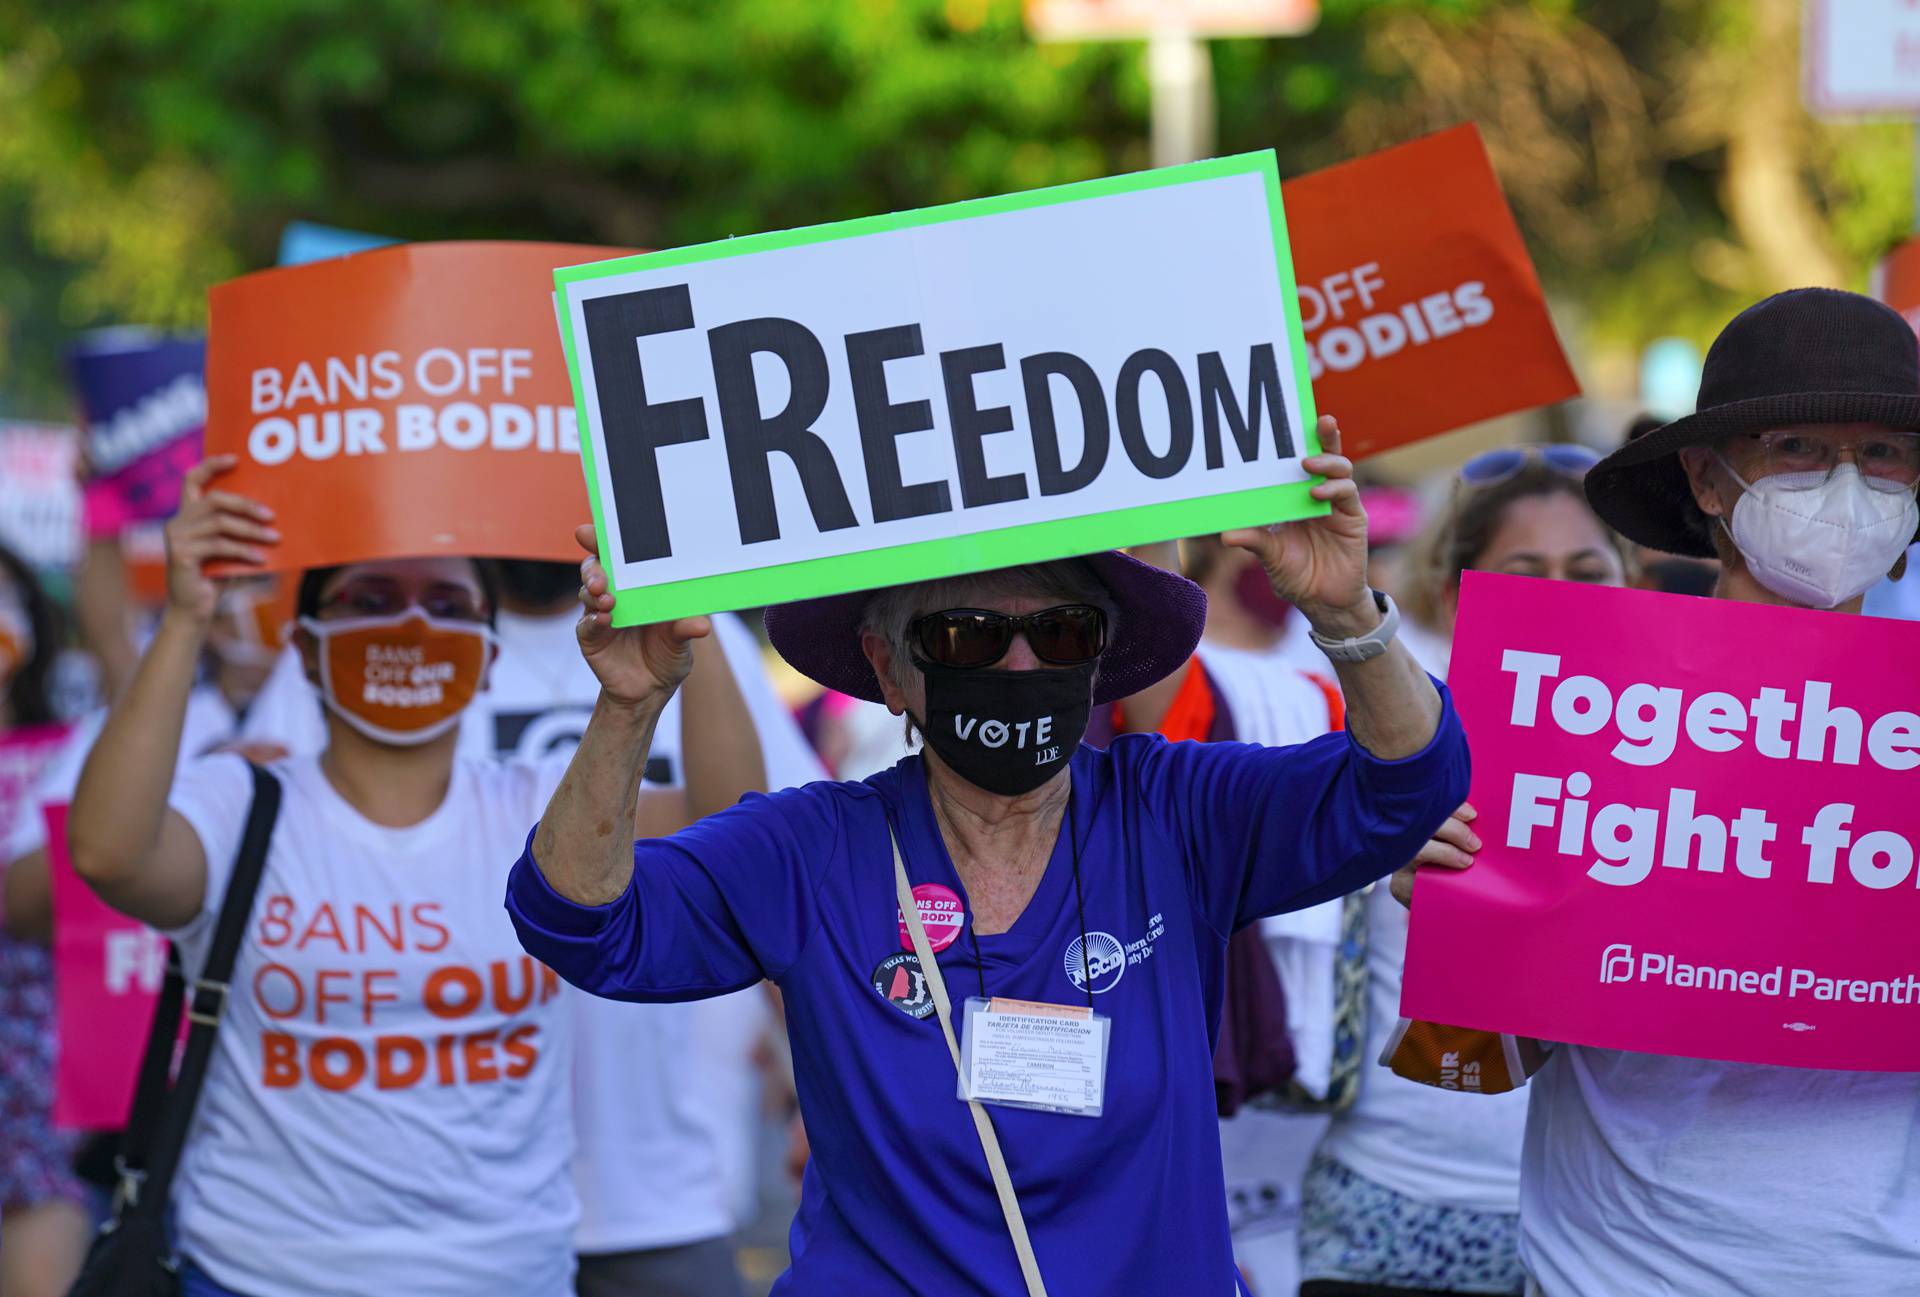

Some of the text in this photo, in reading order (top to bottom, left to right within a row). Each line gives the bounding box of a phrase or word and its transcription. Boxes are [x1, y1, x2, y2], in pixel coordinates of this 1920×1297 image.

[251, 347, 532, 414] BANS OFF
[248, 408, 387, 466] OUR
[582, 283, 1296, 564] FREEDOM
[955, 714, 1053, 749] VOTE
[1501, 649, 1920, 771] Togethe
[1034, 745, 1064, 766] LDF
[1506, 768, 1920, 890] Fight fo
[260, 896, 451, 952] BANS
[921, 913, 954, 922] BODY
[934, 901, 957, 910] OFF
[884, 955, 920, 970] TEXAS WO
[1640, 952, 1920, 1004] Planned Parenth
[253, 963, 399, 1026] OFF
[999, 1015, 1080, 1027] IDENTIFICATION CARD
[987, 1021, 1019, 1029] TARJETA
[261, 1024, 540, 1092] BODIES
